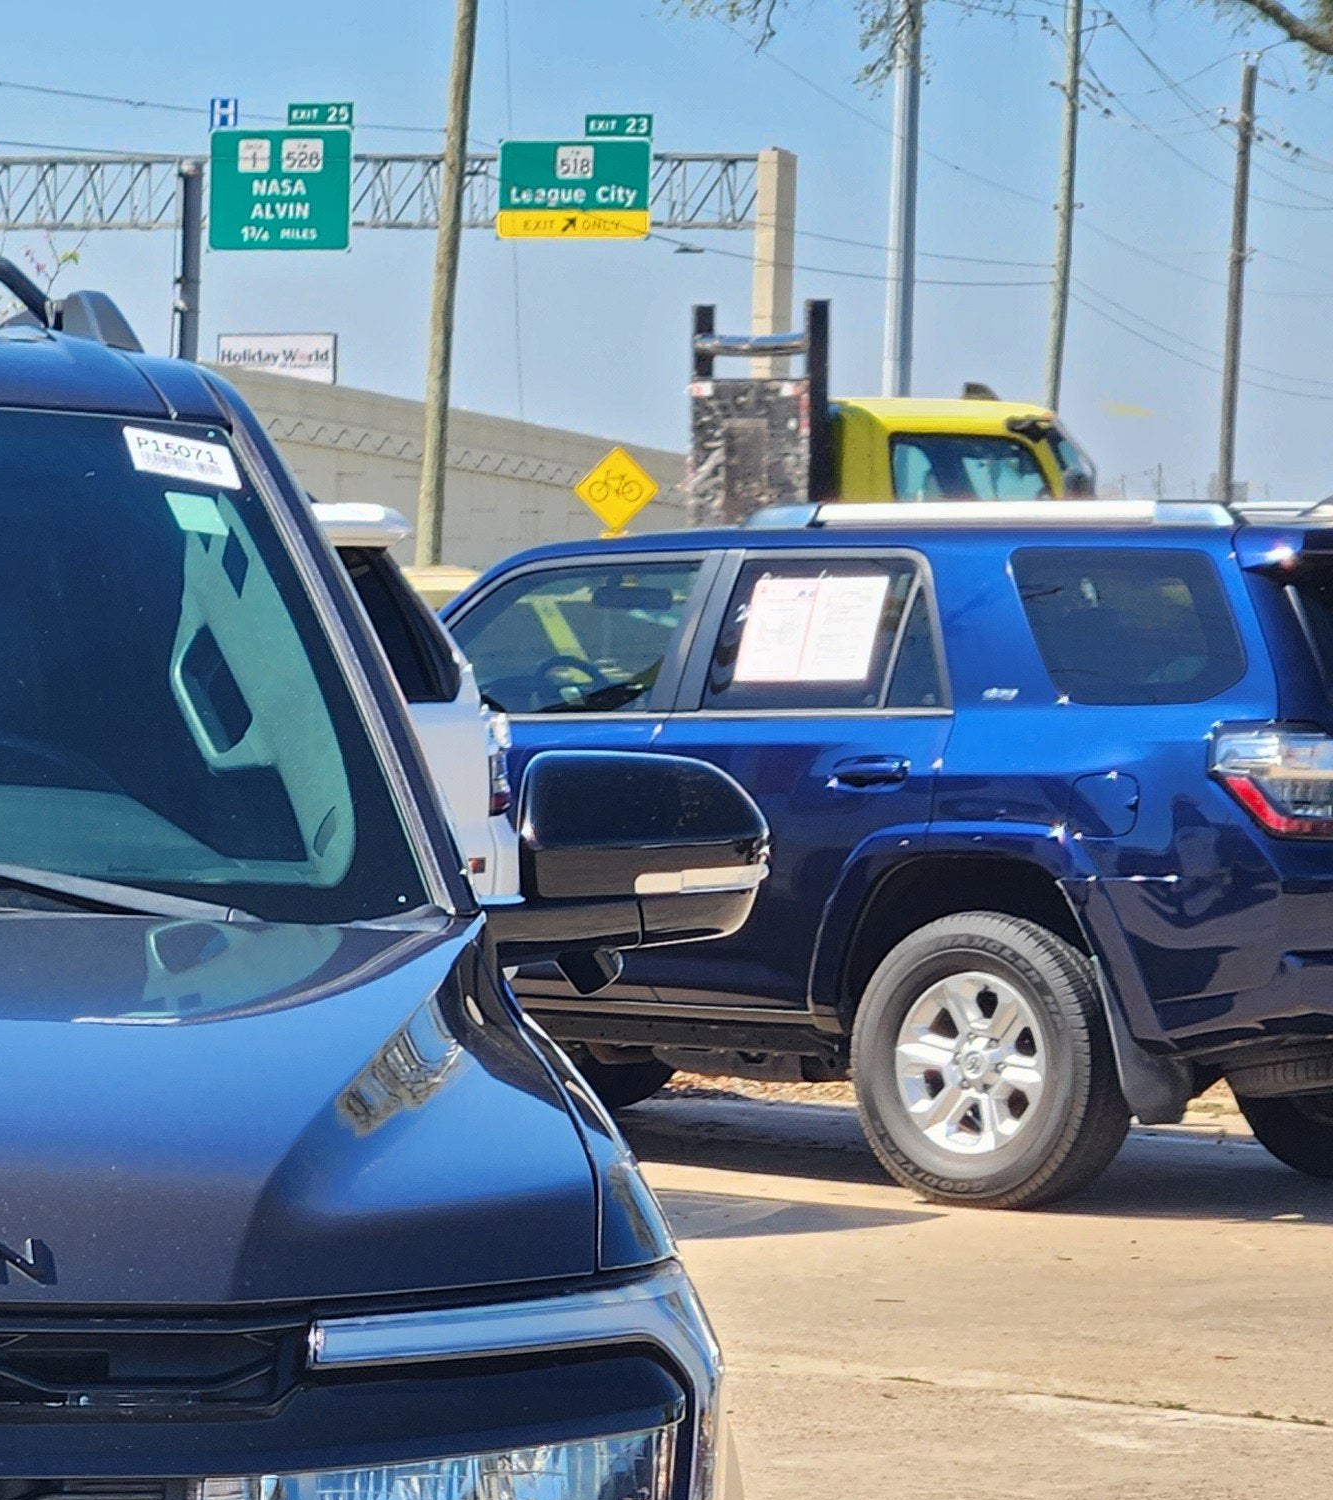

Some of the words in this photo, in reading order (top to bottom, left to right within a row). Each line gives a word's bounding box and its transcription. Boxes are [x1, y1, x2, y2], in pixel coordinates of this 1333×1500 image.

[291, 109, 319, 120] EXIT
[327, 105, 349, 122] 25
[589, 119, 617, 132] EXIT
[625, 117, 649, 133] 23
[285, 151, 321, 169] 528
[560, 157, 591, 175] 518
[252, 178, 307, 196] NASA
[510, 186, 586, 208] League
[596, 184, 638, 208] City
[250, 202, 311, 220] ALVIN
[523, 219, 555, 230] EXIT
[582, 219, 621, 230] ONLY
[280, 228, 318, 240] MILES
[221, 347, 279, 363] Holiday
[136, 436, 218, 465] P15071
